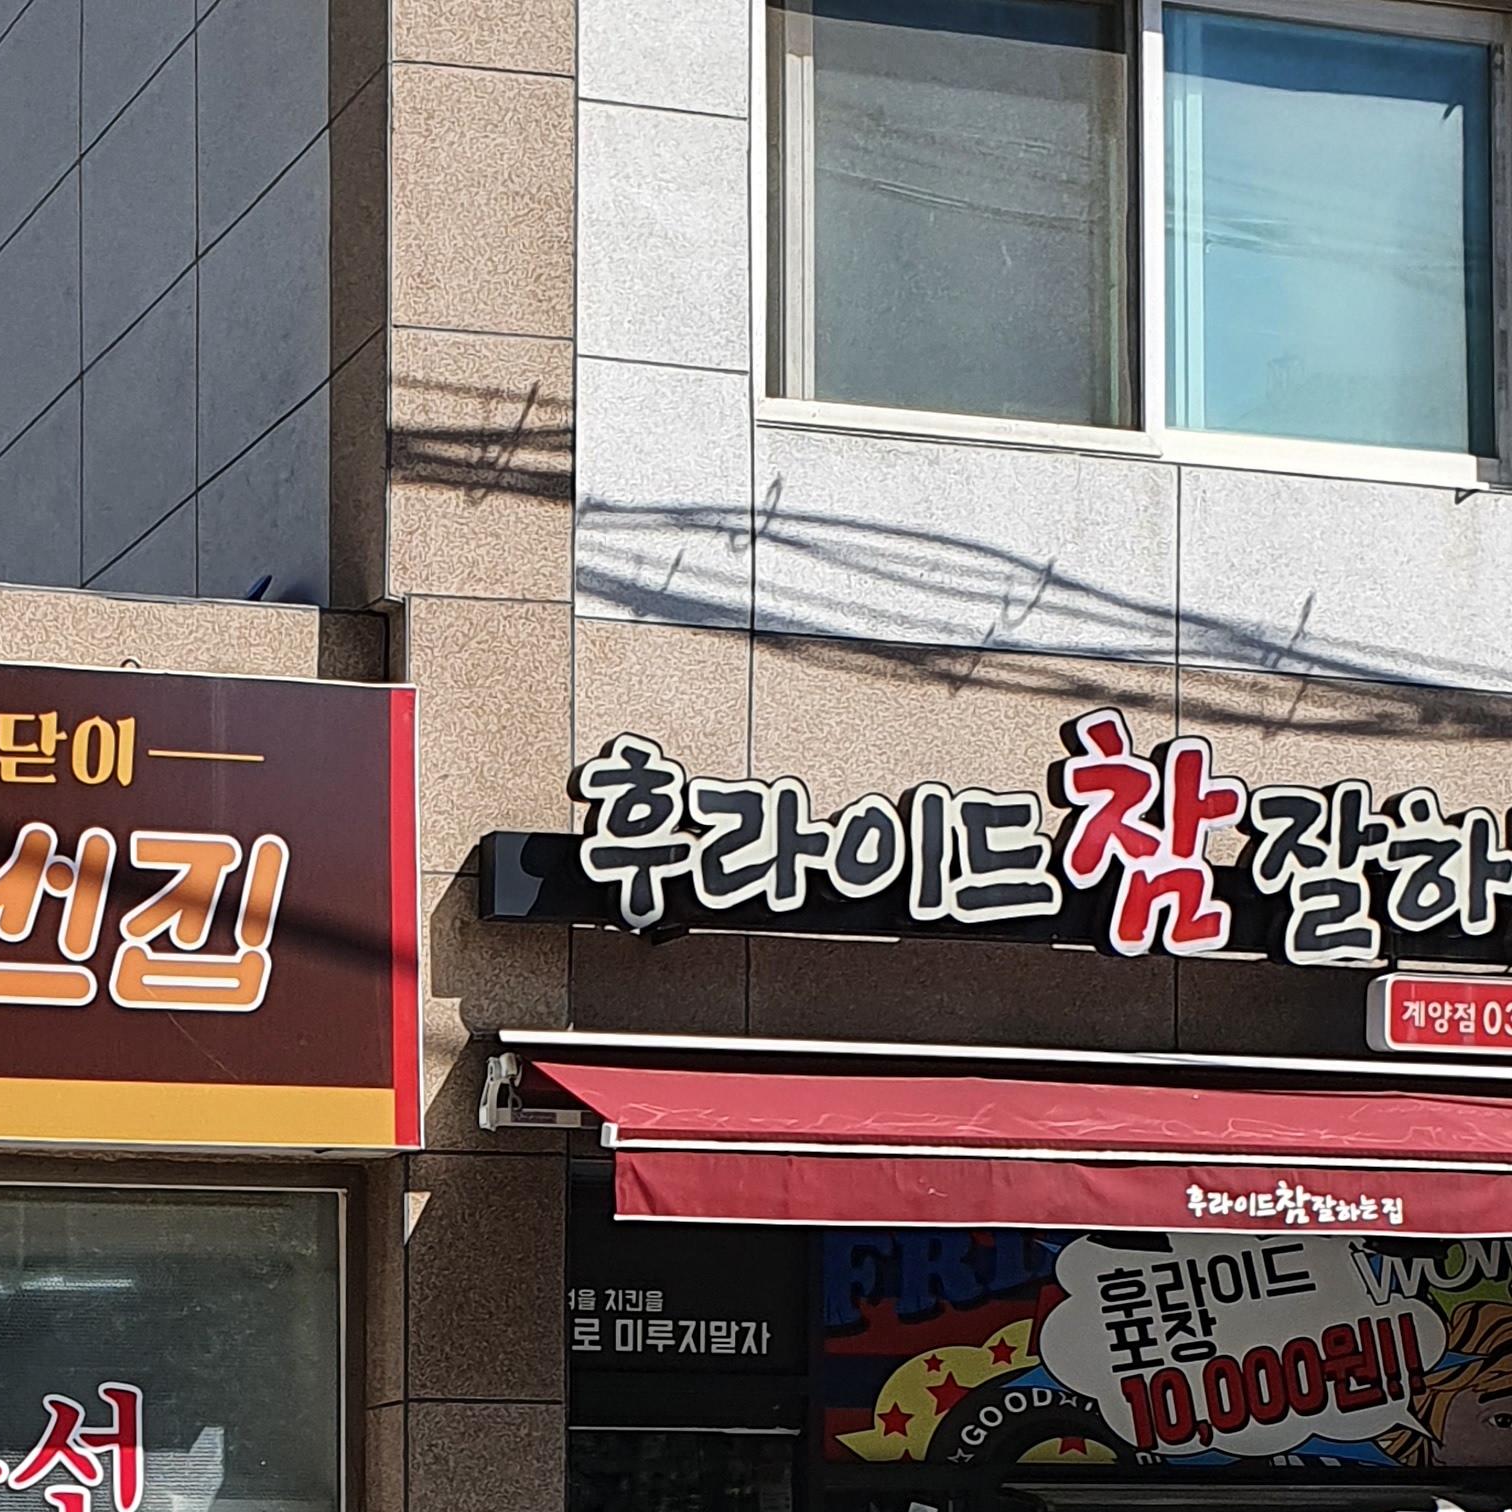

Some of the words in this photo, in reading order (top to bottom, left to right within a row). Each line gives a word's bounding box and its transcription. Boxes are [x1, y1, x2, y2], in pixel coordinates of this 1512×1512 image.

[1402, 1000, 1475, 1034] 계양점
[1186, 1180, 1404, 1225] 후라이드참잘하는집
[604, 1287, 665, 1313] 치킨을
[1097, 1243, 1316, 1322] 후라이드
[614, 1316, 774, 1356] 미루지말자
[1104, 1311, 1217, 1374] 포장
[1120, 1311, 1428, 1453] 10,000원!!
[959, 1386, 1054, 1448] GOOD
